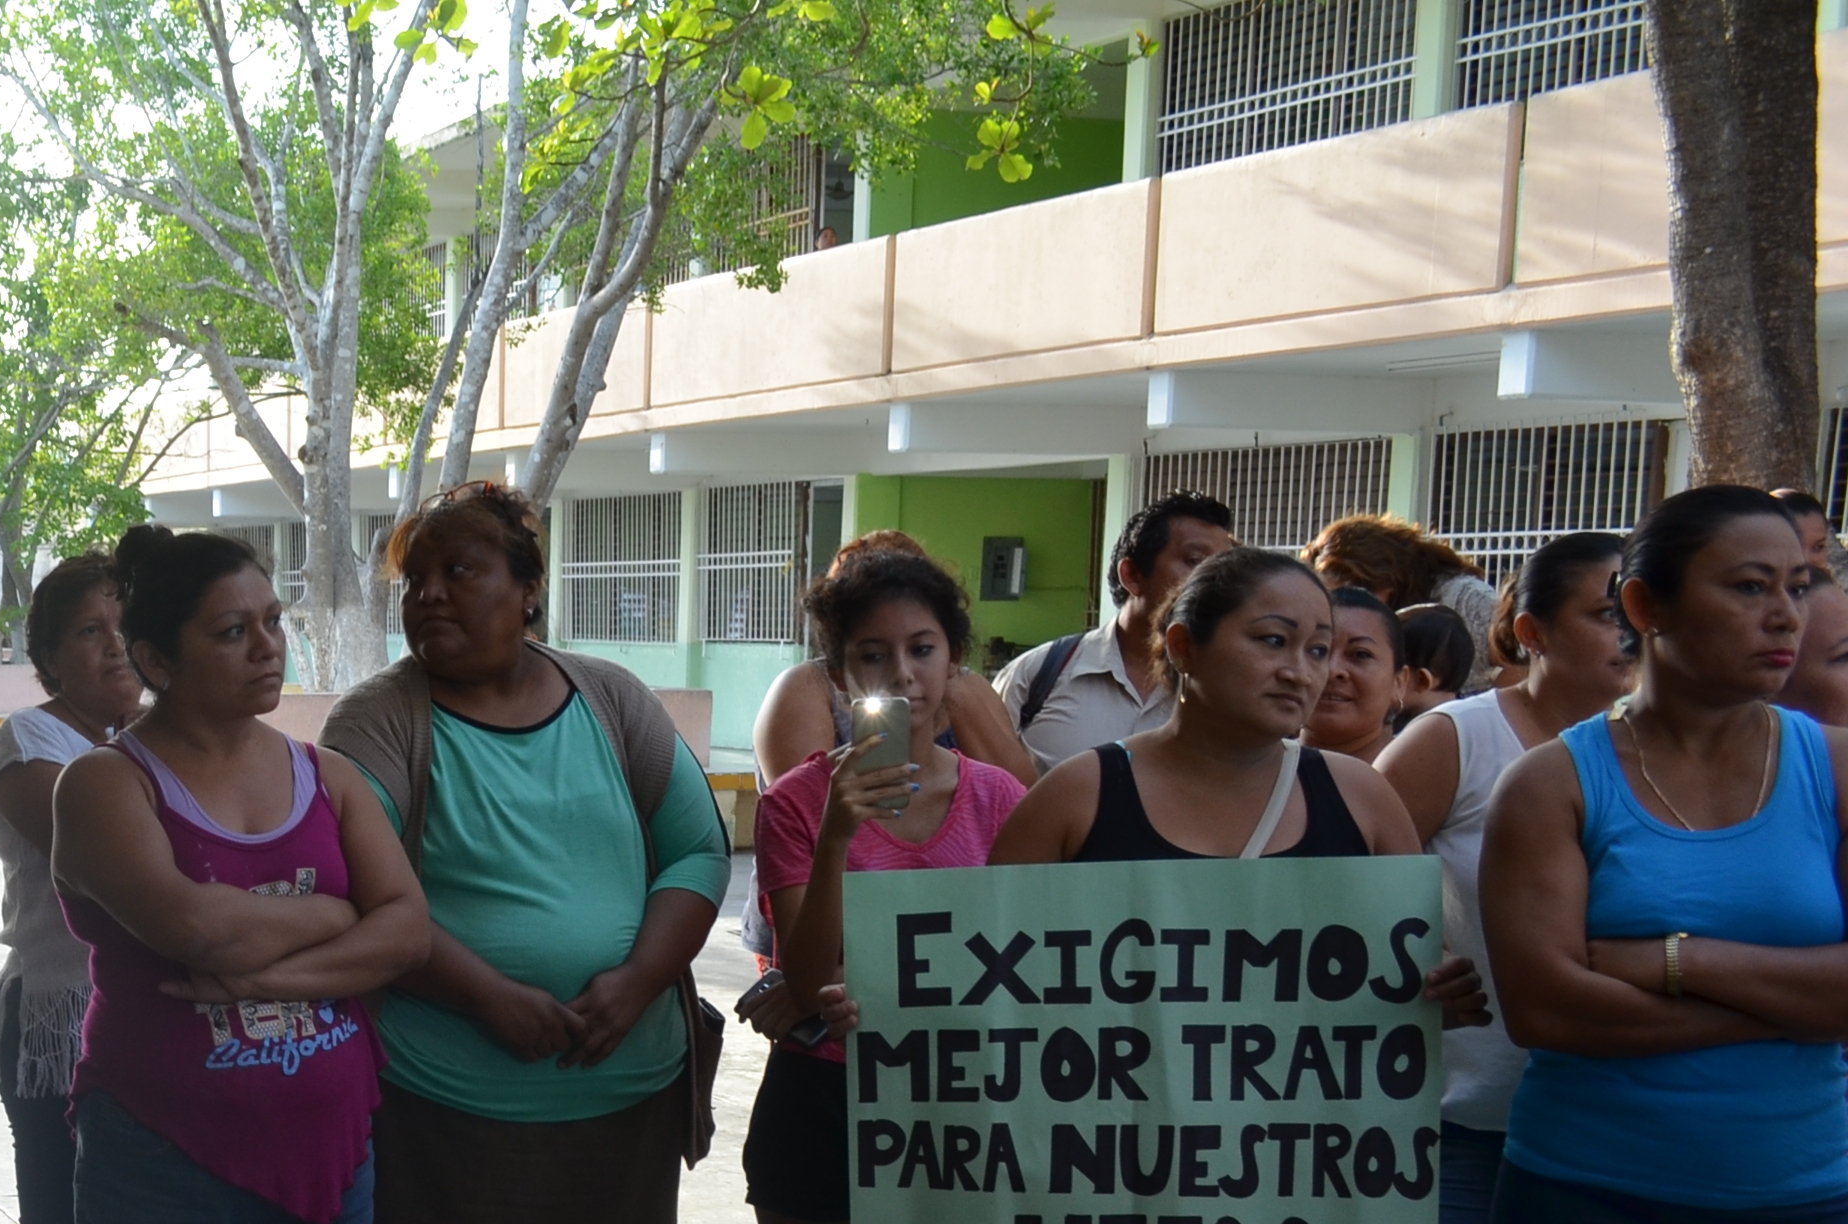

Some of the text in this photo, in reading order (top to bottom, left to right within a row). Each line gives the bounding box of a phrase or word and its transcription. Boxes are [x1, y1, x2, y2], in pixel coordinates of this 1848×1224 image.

[896, 911, 1430, 1007] EXIGIMOS
[205, 1015, 358, 1076] California
[857, 1024, 1427, 1103] MEJOR TRATO
[857, 1118, 1441, 1198] PARA NUESTROS
